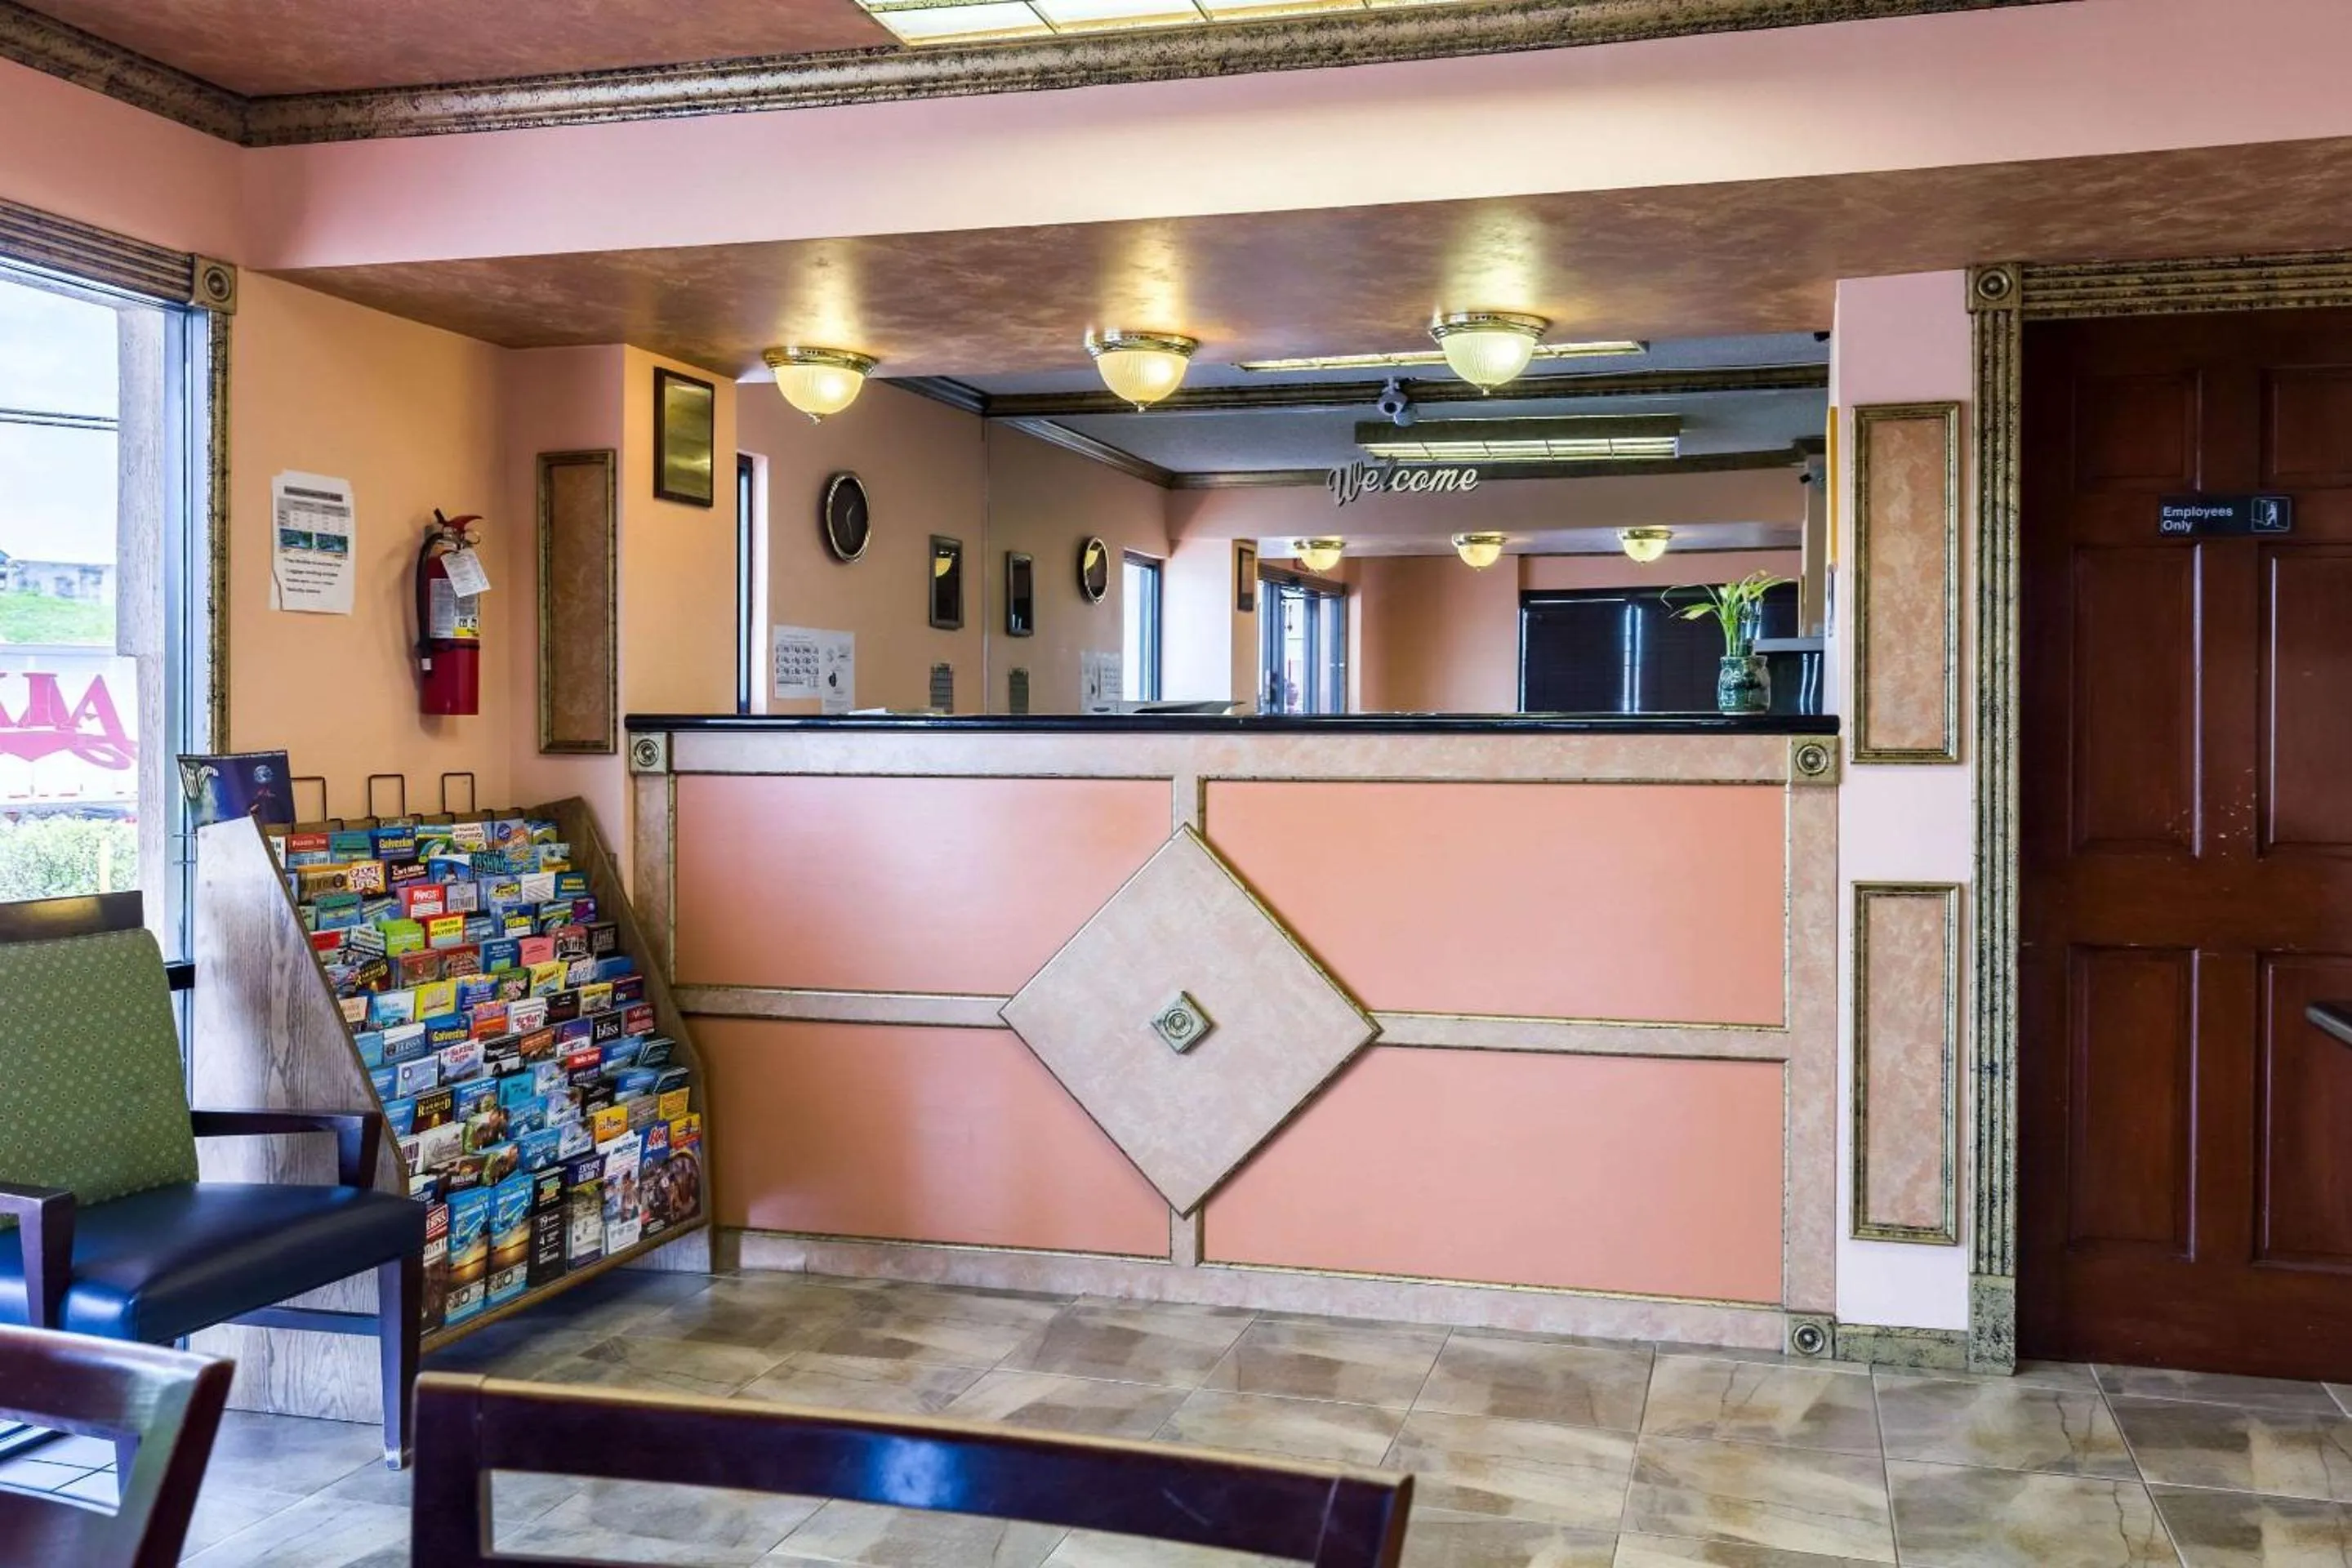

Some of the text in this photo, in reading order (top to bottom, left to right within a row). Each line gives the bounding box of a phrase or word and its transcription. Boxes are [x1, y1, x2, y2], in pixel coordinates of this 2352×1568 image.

[1327, 455, 1479, 506] Welcome
[2163, 506, 2234, 519] Employees
[2163, 520, 2193, 532] Only
